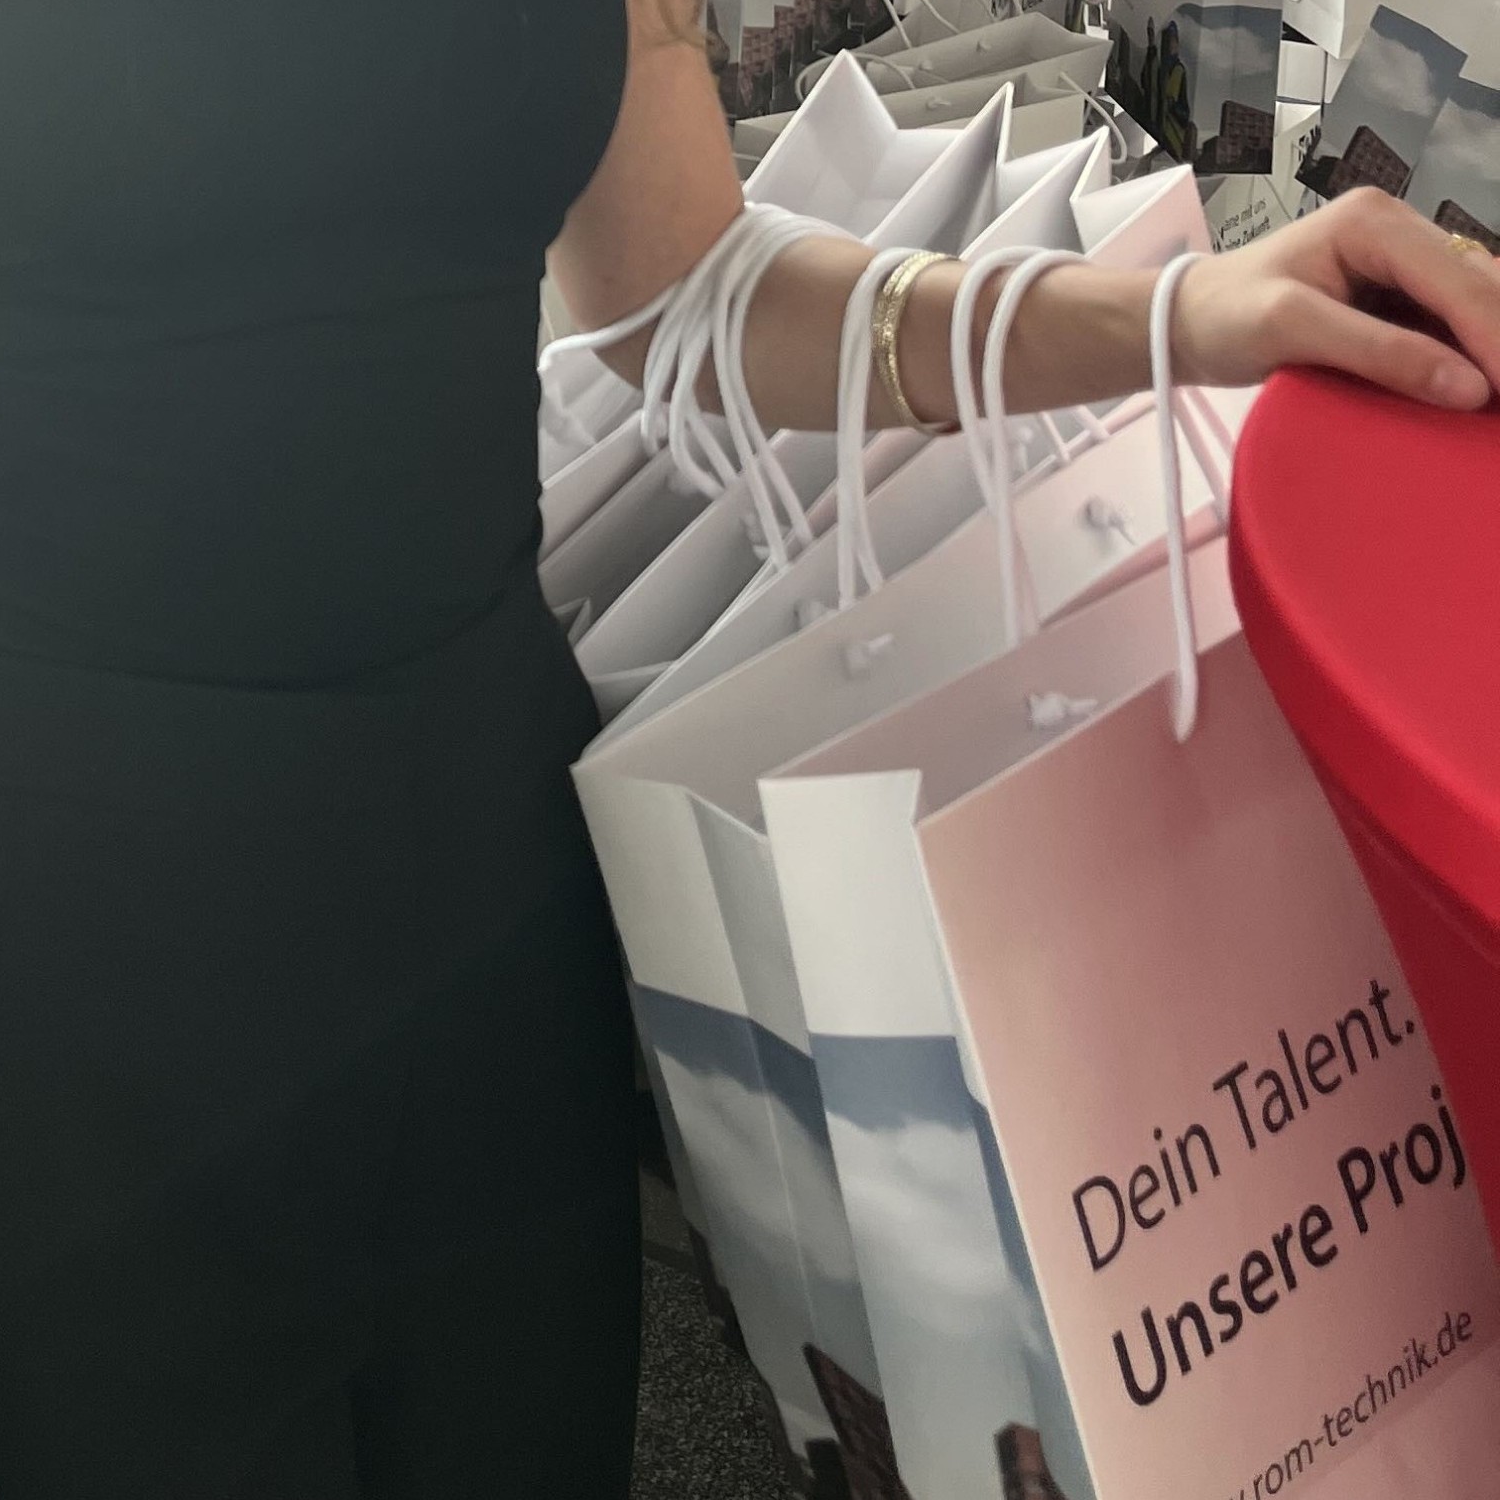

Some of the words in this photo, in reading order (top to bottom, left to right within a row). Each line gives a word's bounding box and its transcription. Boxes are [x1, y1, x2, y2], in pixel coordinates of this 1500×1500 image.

[1071, 1122, 1220, 1272] Dein
[1213, 979, 1416, 1152] Talent.
[1111, 1202, 1339, 1408] Unsere
